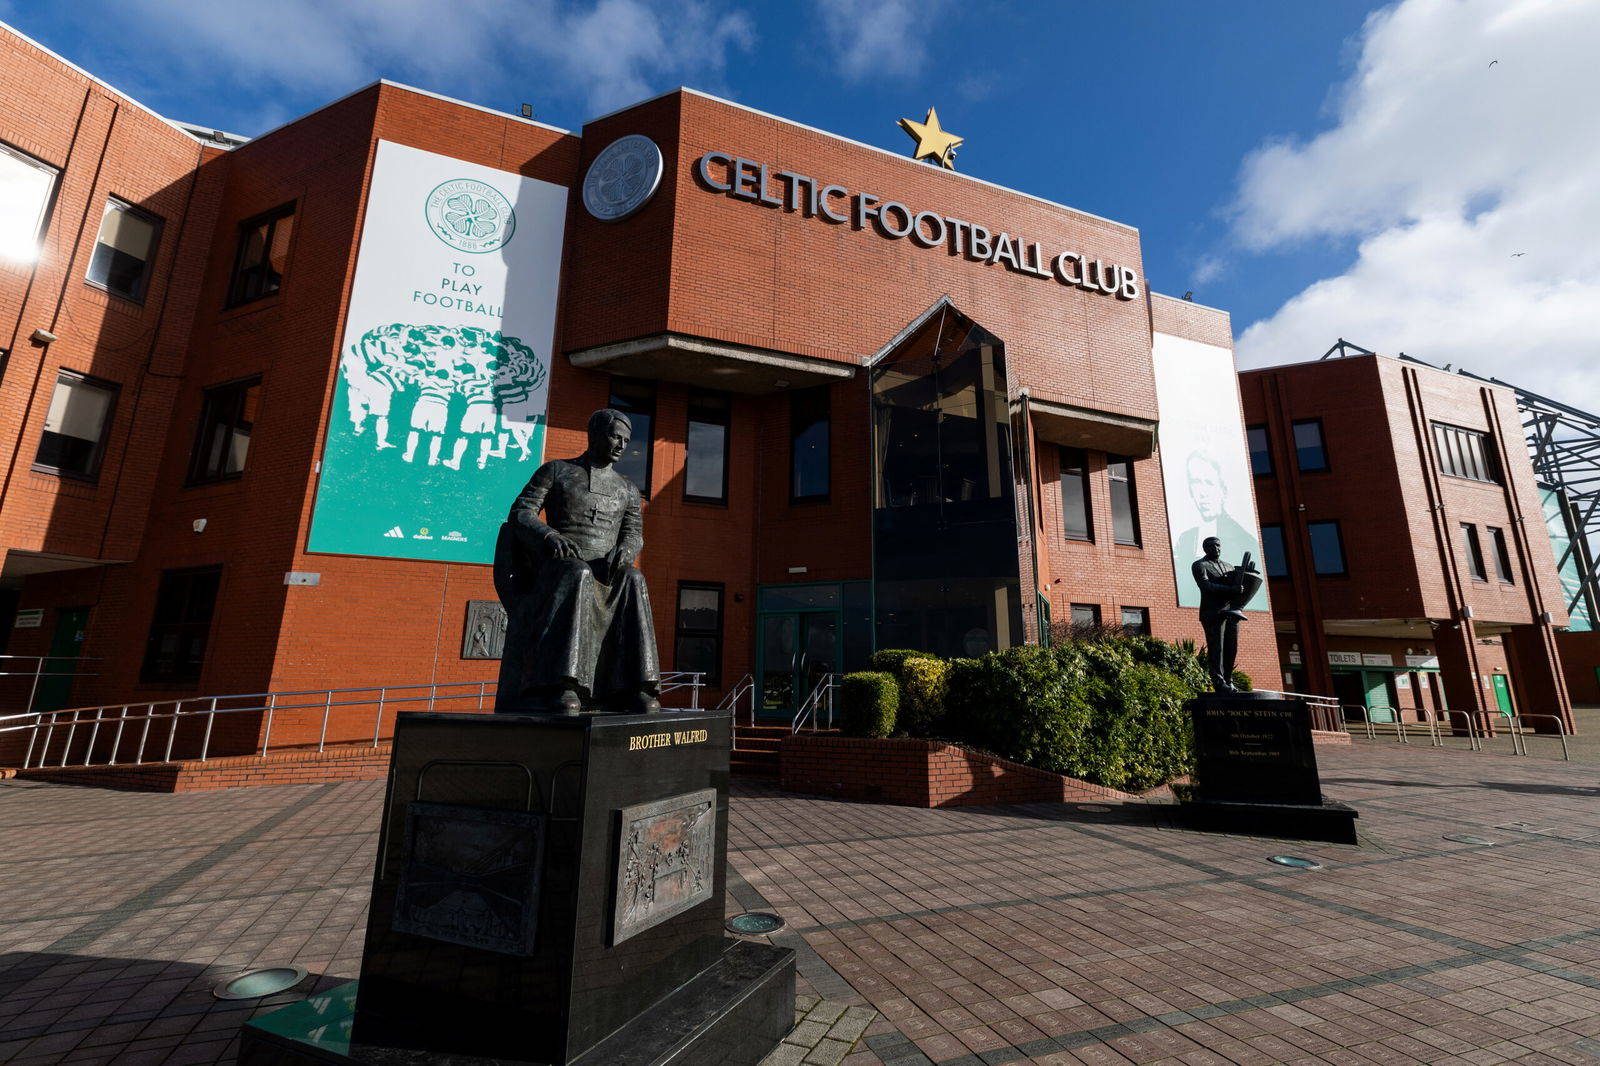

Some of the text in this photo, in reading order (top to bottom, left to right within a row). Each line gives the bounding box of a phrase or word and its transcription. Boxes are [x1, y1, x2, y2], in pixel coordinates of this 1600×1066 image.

[430, 194, 443, 209] THE
[699, 151, 848, 223] CELTIC
[858, 192, 1054, 279] FOOTBALL
[1057, 251, 1140, 301] CLUB
[453, 262, 475, 277] TO
[441, 278, 482, 296] PLAY
[413, 290, 504, 319] FOOTBALL
[1329, 653, 1357, 664] TOILETS
[629, 729, 708, 751] BROTHER WALFRID
